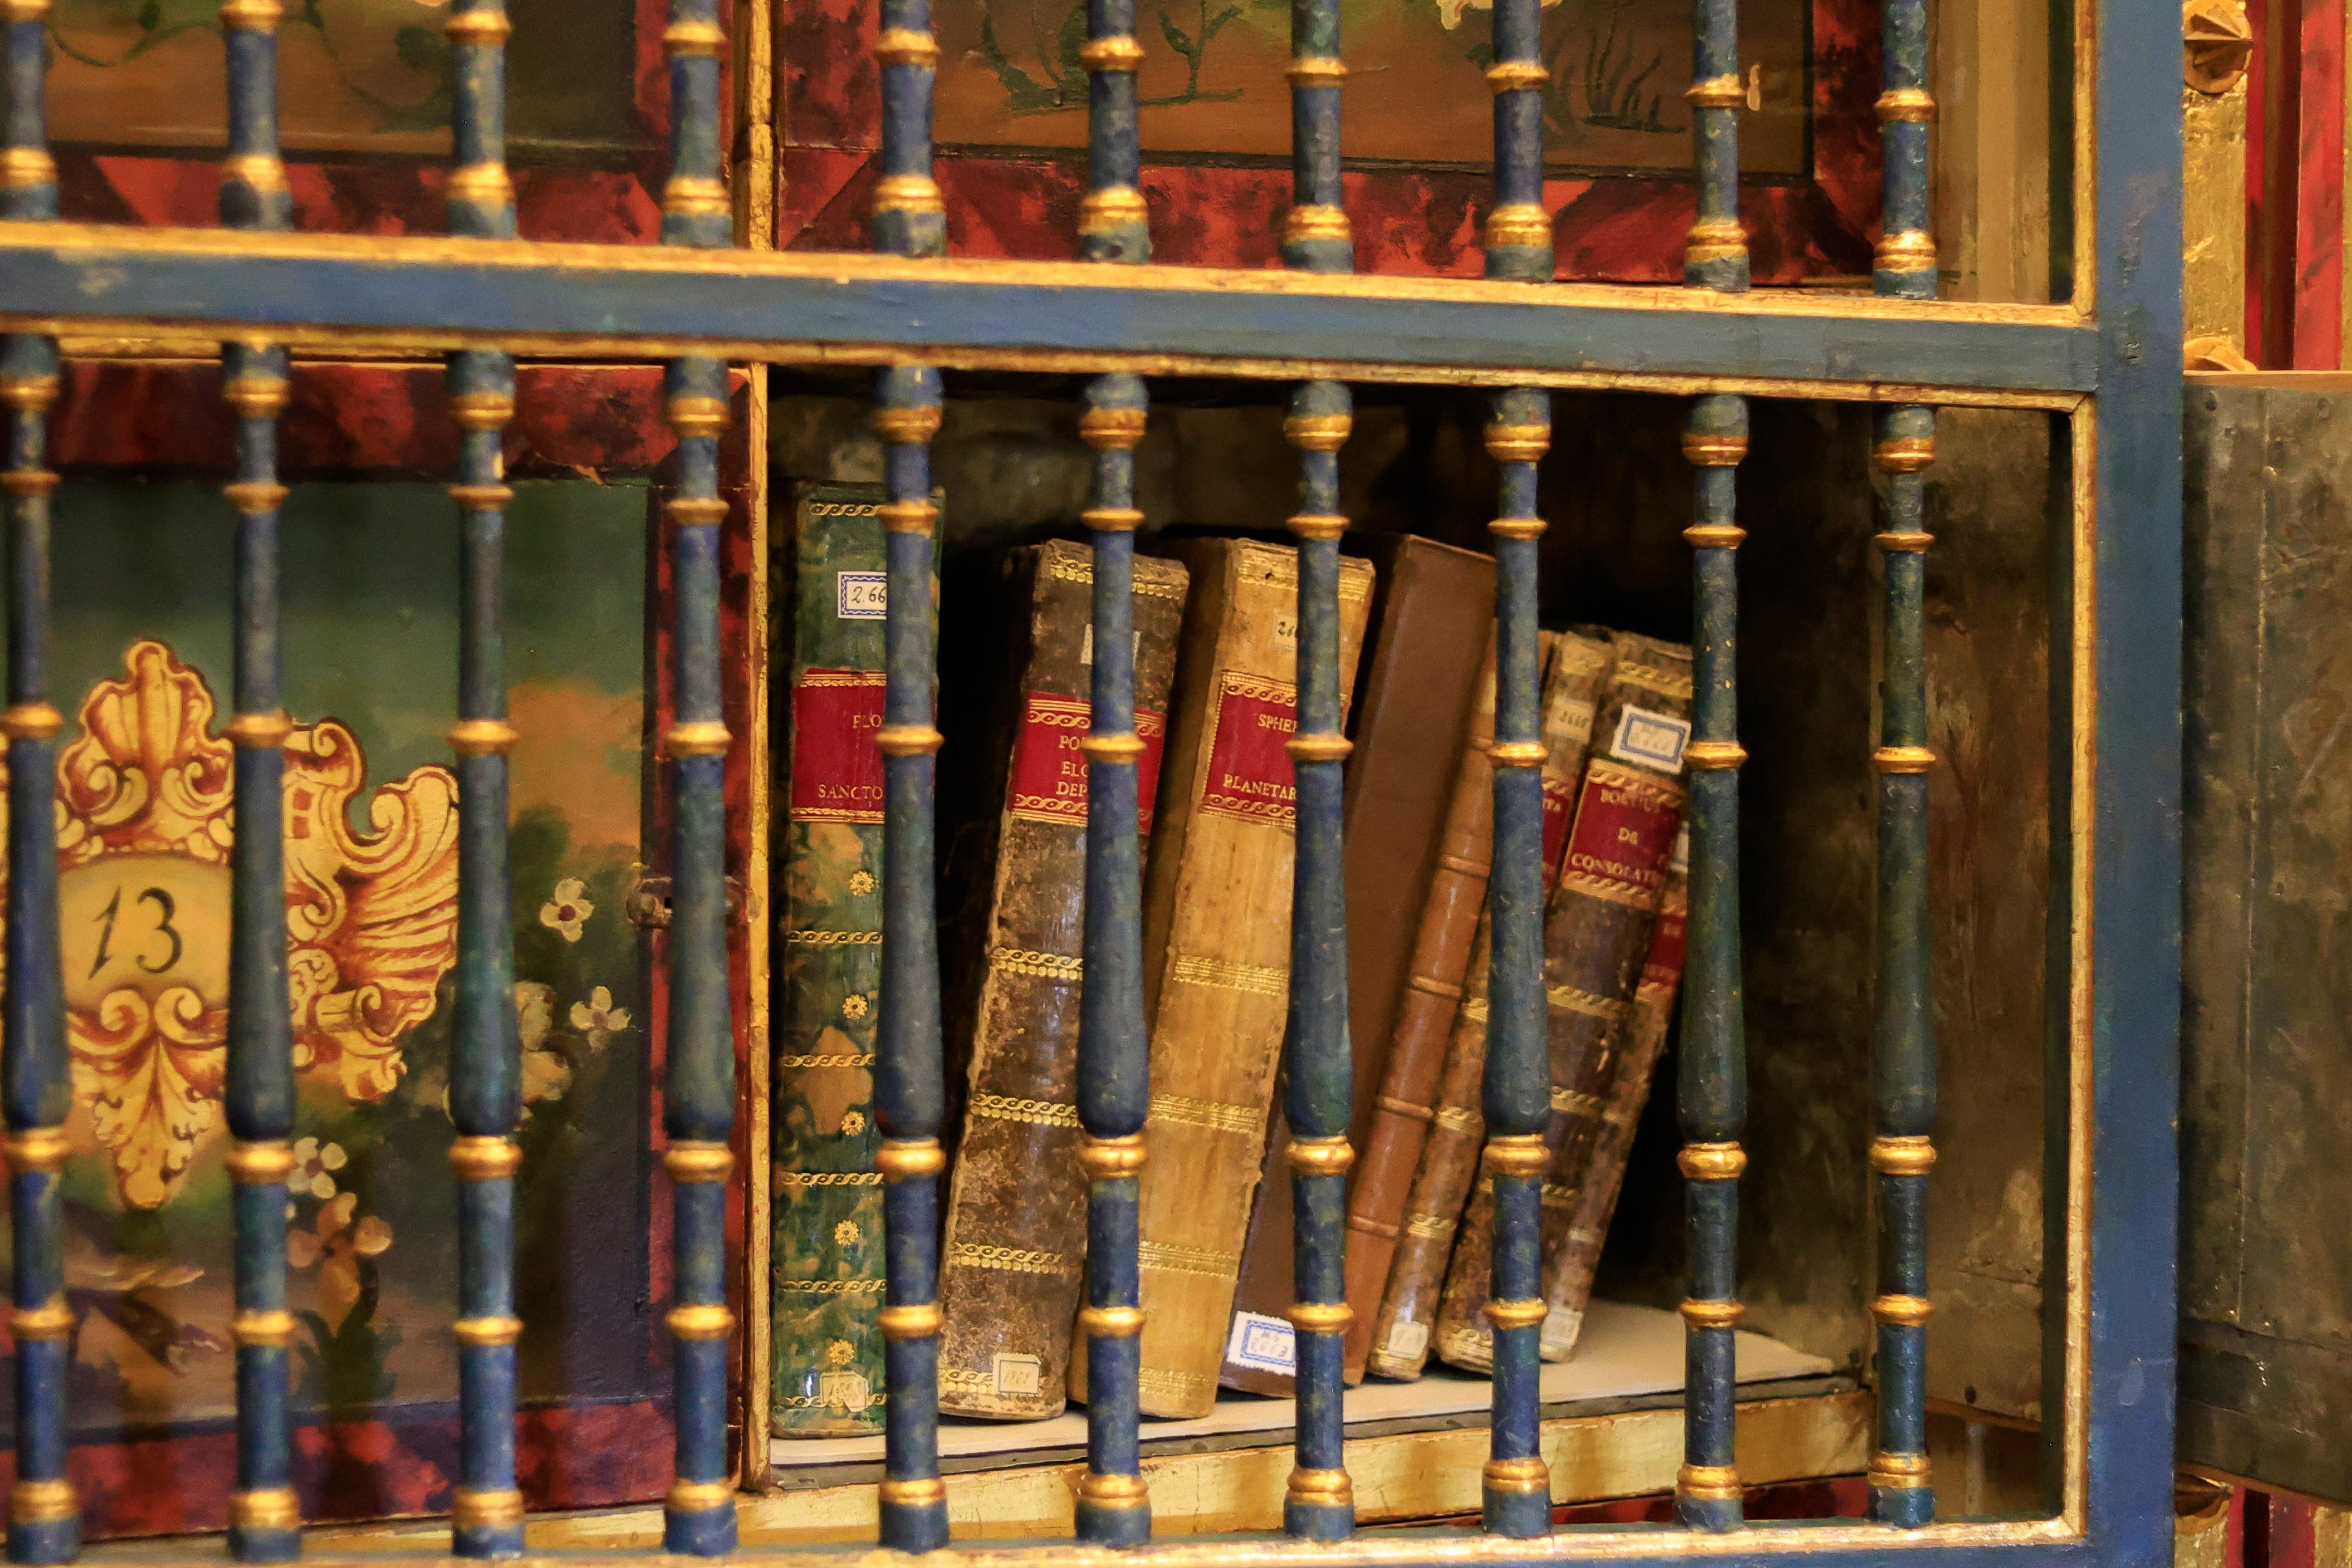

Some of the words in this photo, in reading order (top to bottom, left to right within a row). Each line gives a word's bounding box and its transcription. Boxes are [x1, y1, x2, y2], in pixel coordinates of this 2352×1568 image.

[852, 714, 884, 729] FLO
[1059, 735, 1083, 750] PO
[88, 885, 183, 980] 13
